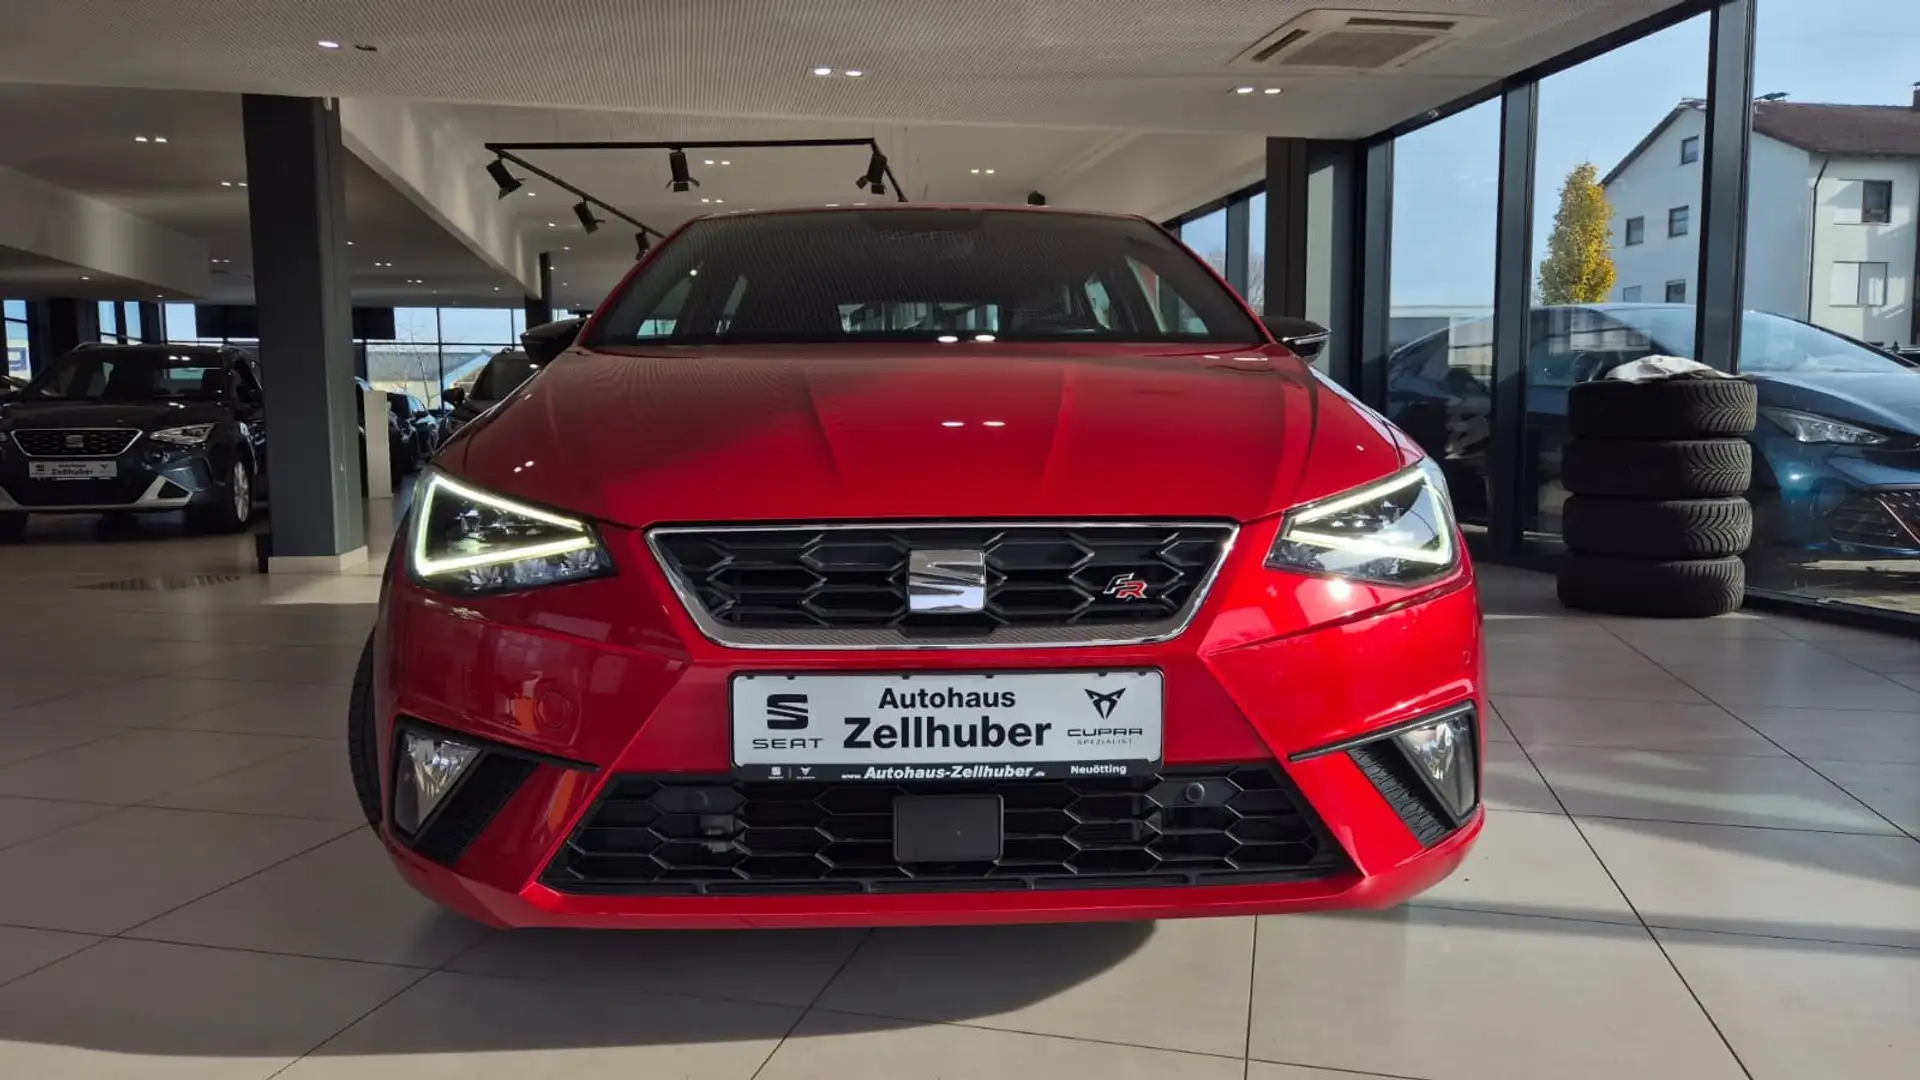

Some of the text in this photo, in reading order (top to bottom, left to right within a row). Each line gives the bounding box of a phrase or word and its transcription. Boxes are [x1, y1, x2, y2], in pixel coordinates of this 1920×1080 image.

[1102, 572, 1148, 600] FR
[878, 687, 1016, 709] Autohaus
[843, 715, 1053, 748] Zellhuber
[1067, 728, 1143, 737] CUPRA
[752, 738, 824, 749] SEAT
[1070, 764, 1127, 775] Neuötting
